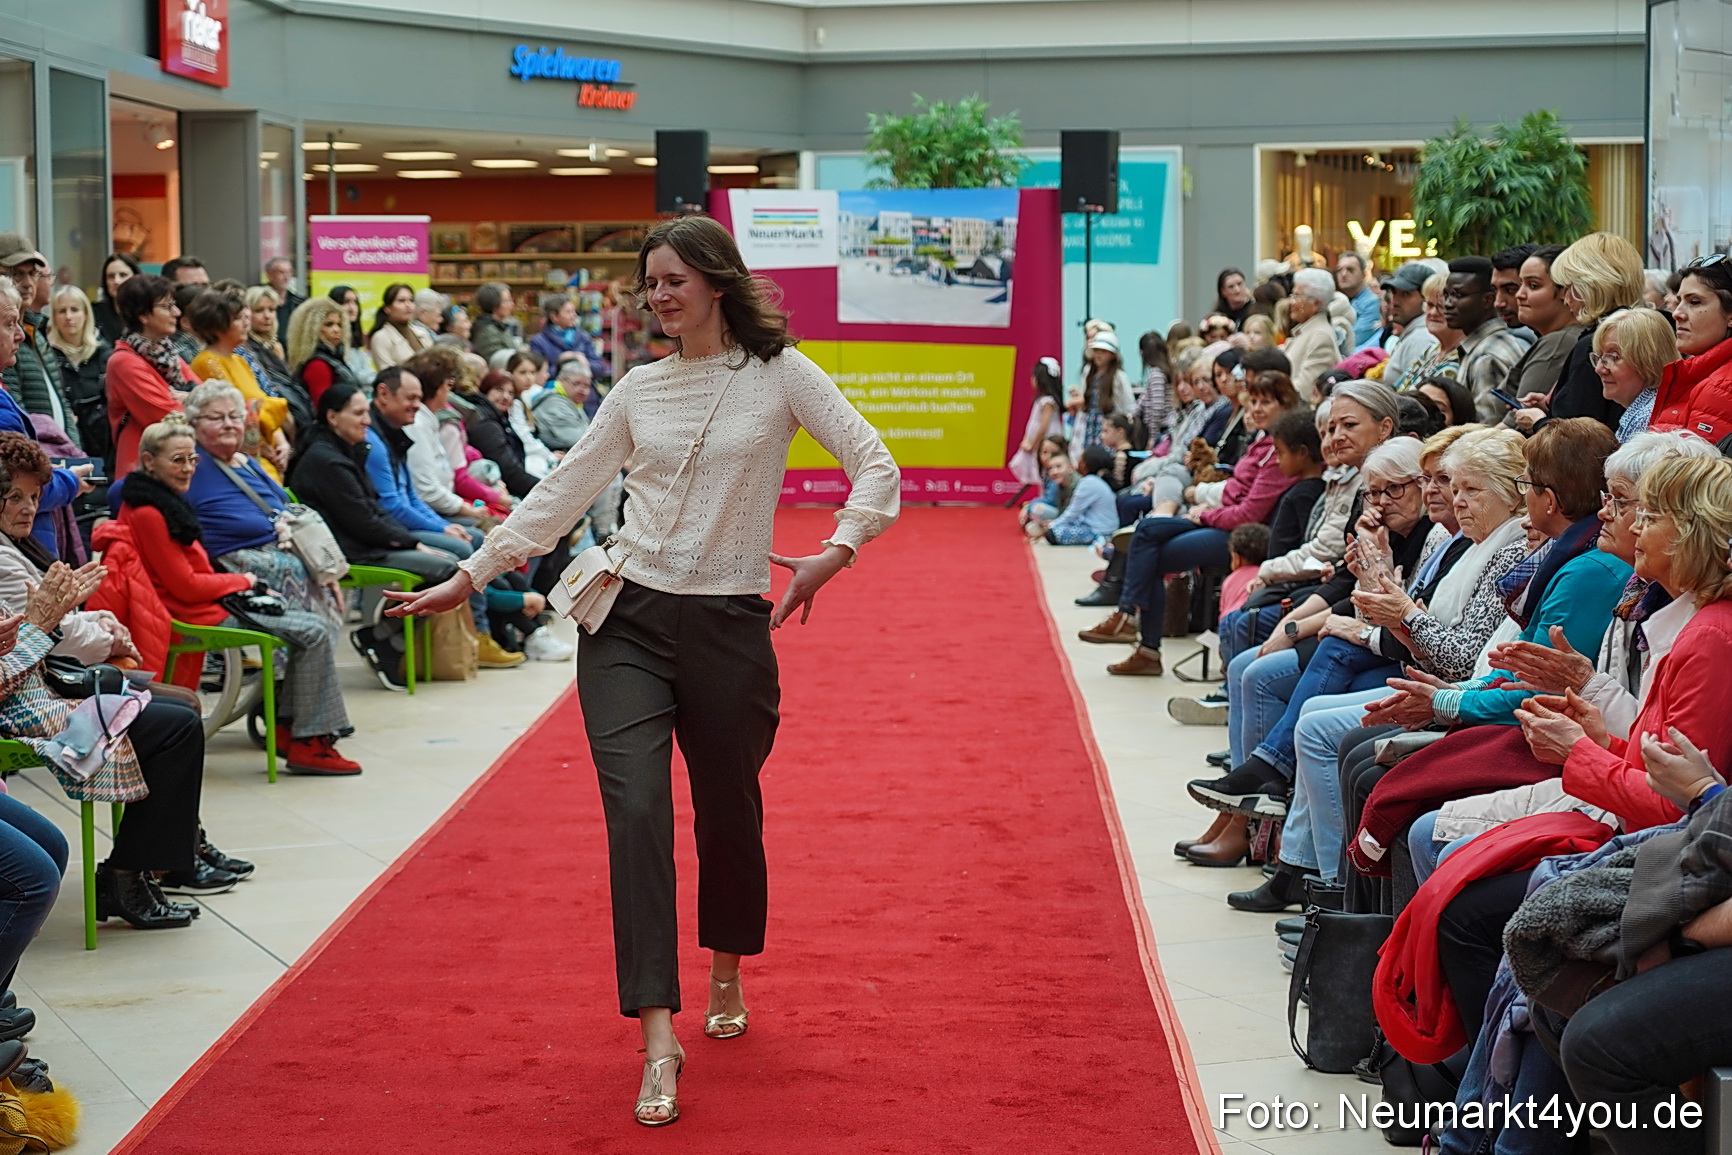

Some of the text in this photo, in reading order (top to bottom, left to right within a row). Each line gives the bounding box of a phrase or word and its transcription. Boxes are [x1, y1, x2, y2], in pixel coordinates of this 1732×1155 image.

[511, 45, 621, 82] Spielwaren
[318, 235, 418, 250] Verschenken Sie
[343, 250, 418, 264] Gutscheine!
[871, 372, 900, 383] nicht
[918, 373, 953, 383] einem
[955, 371, 975, 383] Ort
[870, 388, 889, 398] ein
[890, 387, 938, 398] Workout
[942, 387, 986, 398] machen
[856, 402, 975, 413] Traumurlaub buchen.
